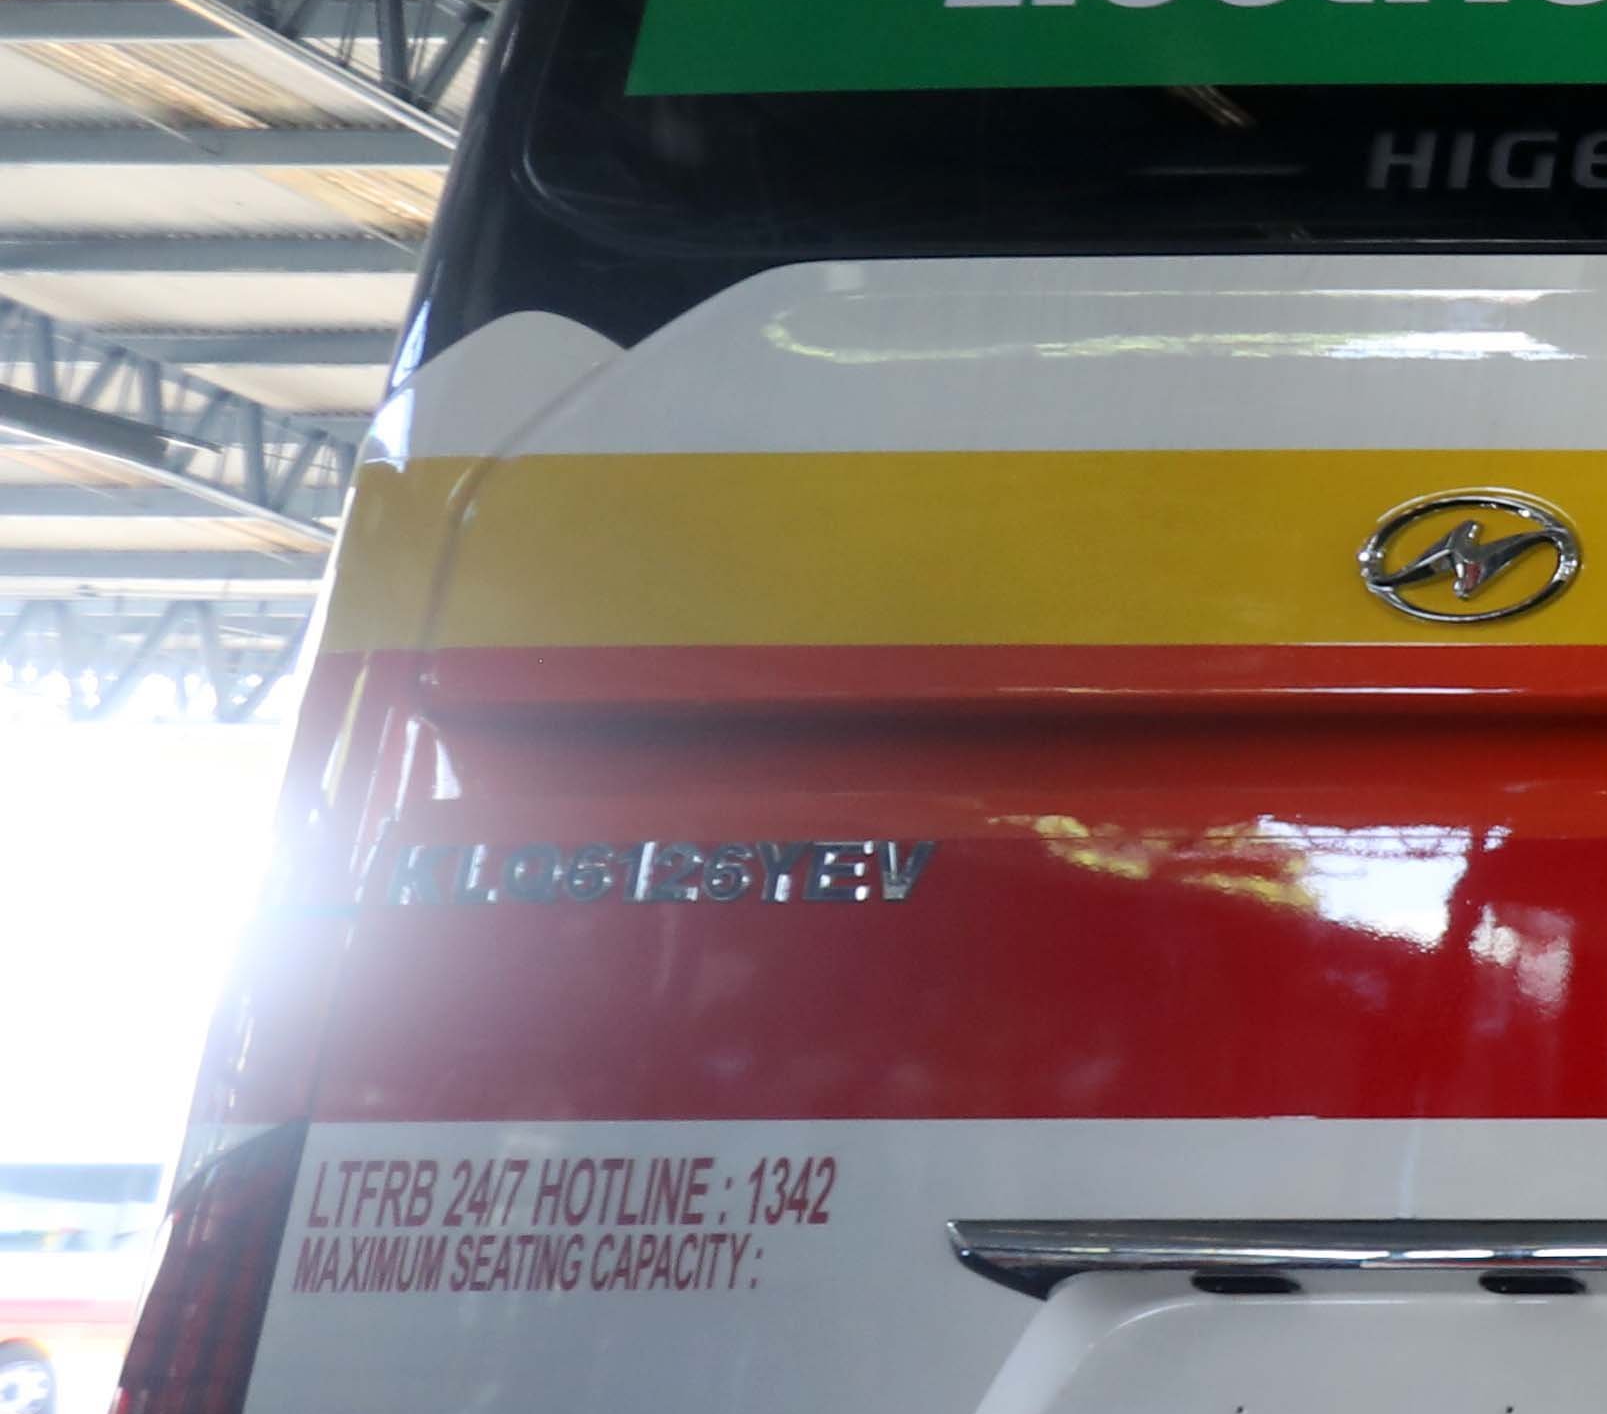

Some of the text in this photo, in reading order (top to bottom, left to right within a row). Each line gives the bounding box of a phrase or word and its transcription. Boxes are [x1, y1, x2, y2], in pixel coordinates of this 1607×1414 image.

[388, 840, 937, 904] KLQ6126YEV
[307, 1159, 435, 1228] LTFRB
[443, 1159, 529, 1228] 24/7
[533, 1158, 714, 1226] HOTLINE
[748, 1156, 837, 1225] 1342
[293, 1235, 443, 1293] MAXIMUM
[450, 1234, 583, 1292] SEATING
[590, 1233, 747, 1292] CAPACITY
